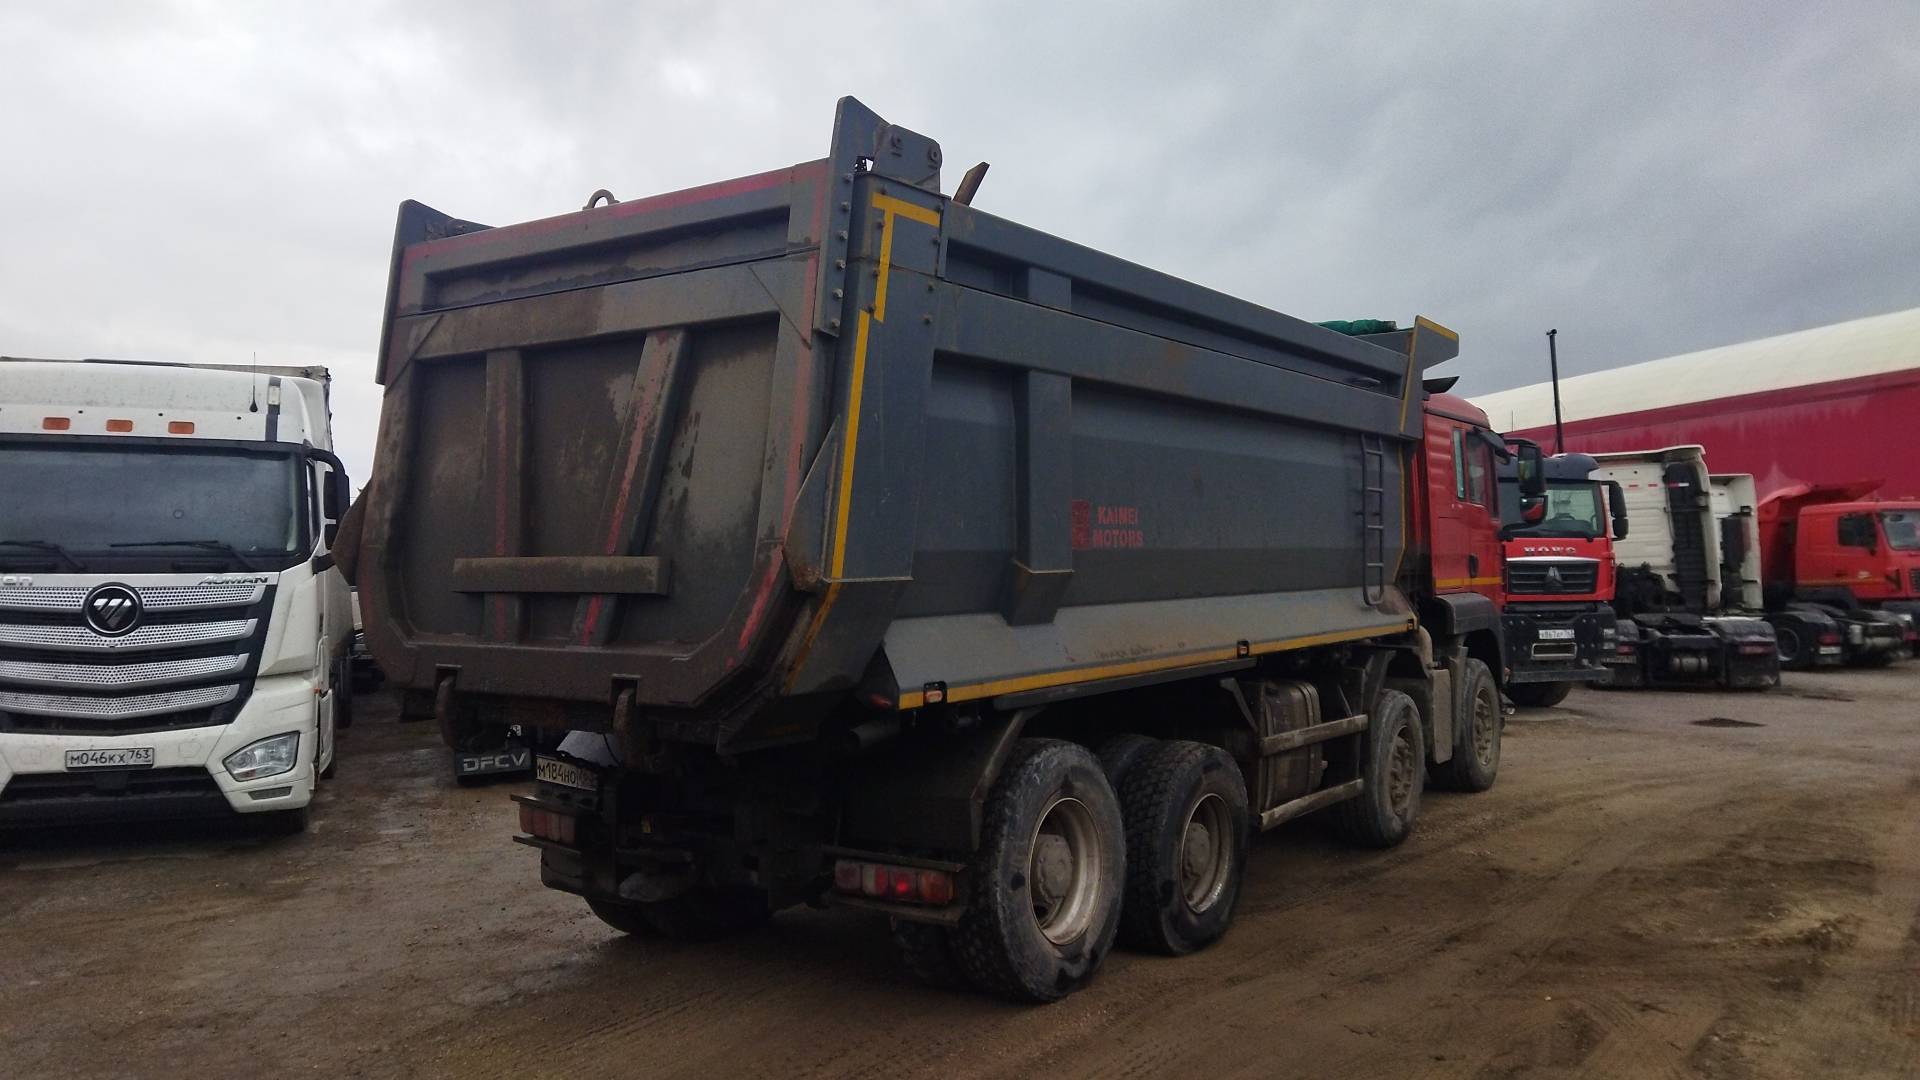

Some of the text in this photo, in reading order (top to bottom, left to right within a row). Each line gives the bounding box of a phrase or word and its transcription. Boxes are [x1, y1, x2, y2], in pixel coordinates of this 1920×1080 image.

[1093, 529, 1144, 548] MOTORS
[197, 575, 269, 586] AUMAN
[463, 752, 527, 772] DFCV
